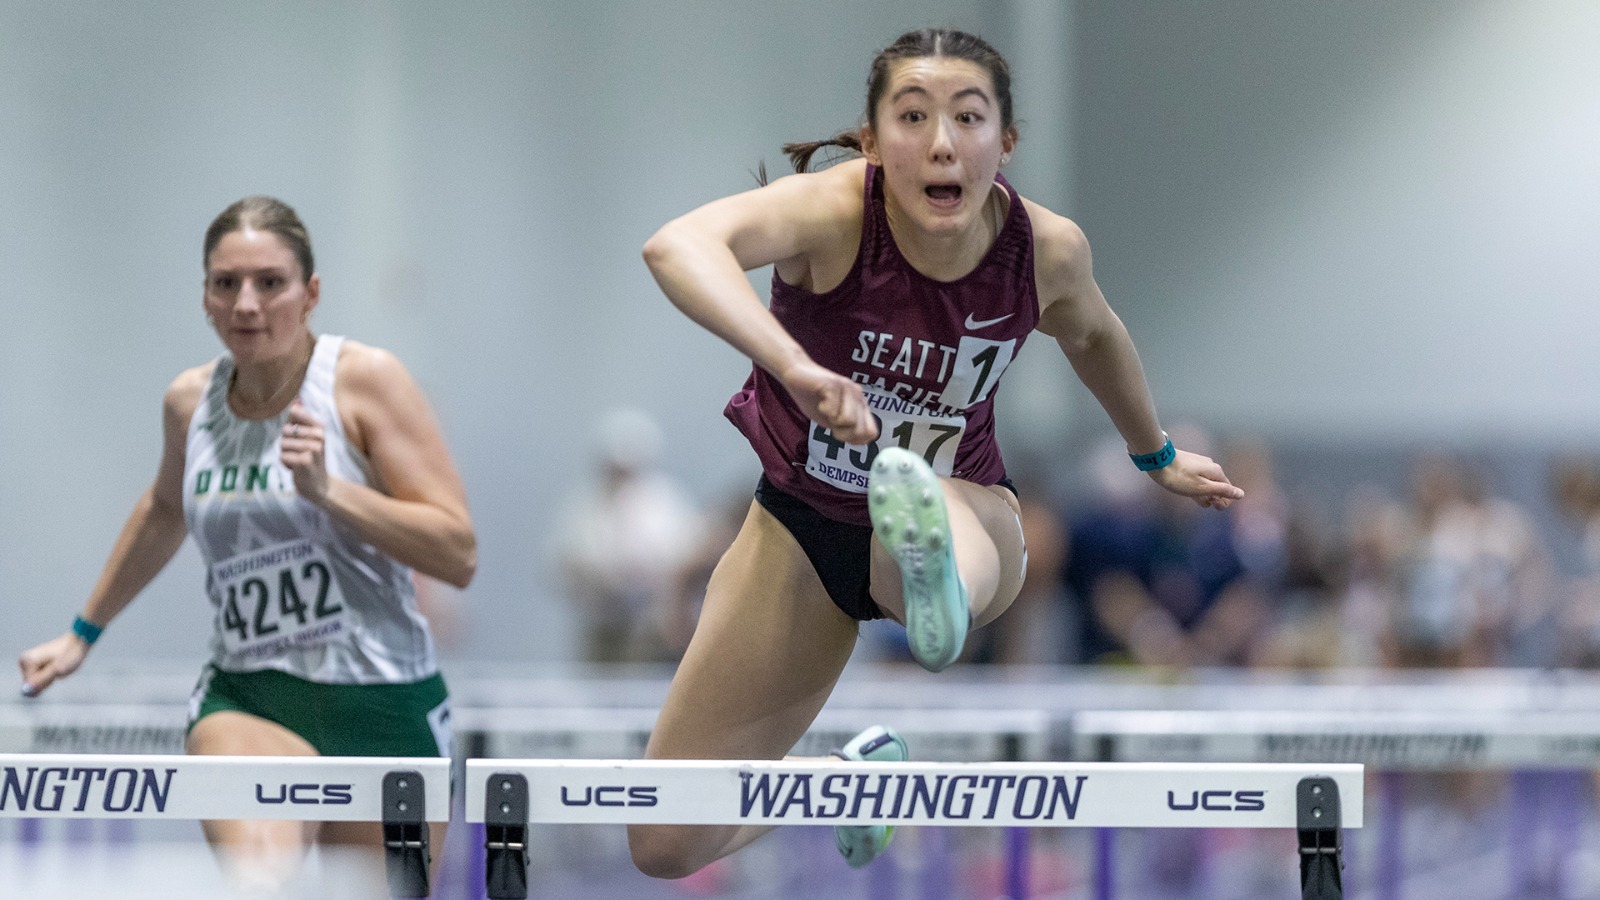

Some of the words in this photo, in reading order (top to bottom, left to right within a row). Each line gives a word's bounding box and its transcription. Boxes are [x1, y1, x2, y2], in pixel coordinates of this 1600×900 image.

[852, 330, 956, 383] SEATT
[968, 345, 1000, 405] 1
[194, 464, 284, 495] DON
[223, 560, 342, 642] 4242
[0, 767, 177, 812] NGTON
[255, 783, 353, 804] UCS
[561, 785, 659, 807] UCS
[739, 773, 1088, 820] WASHINGTON
[1167, 790, 1266, 811] UCS
